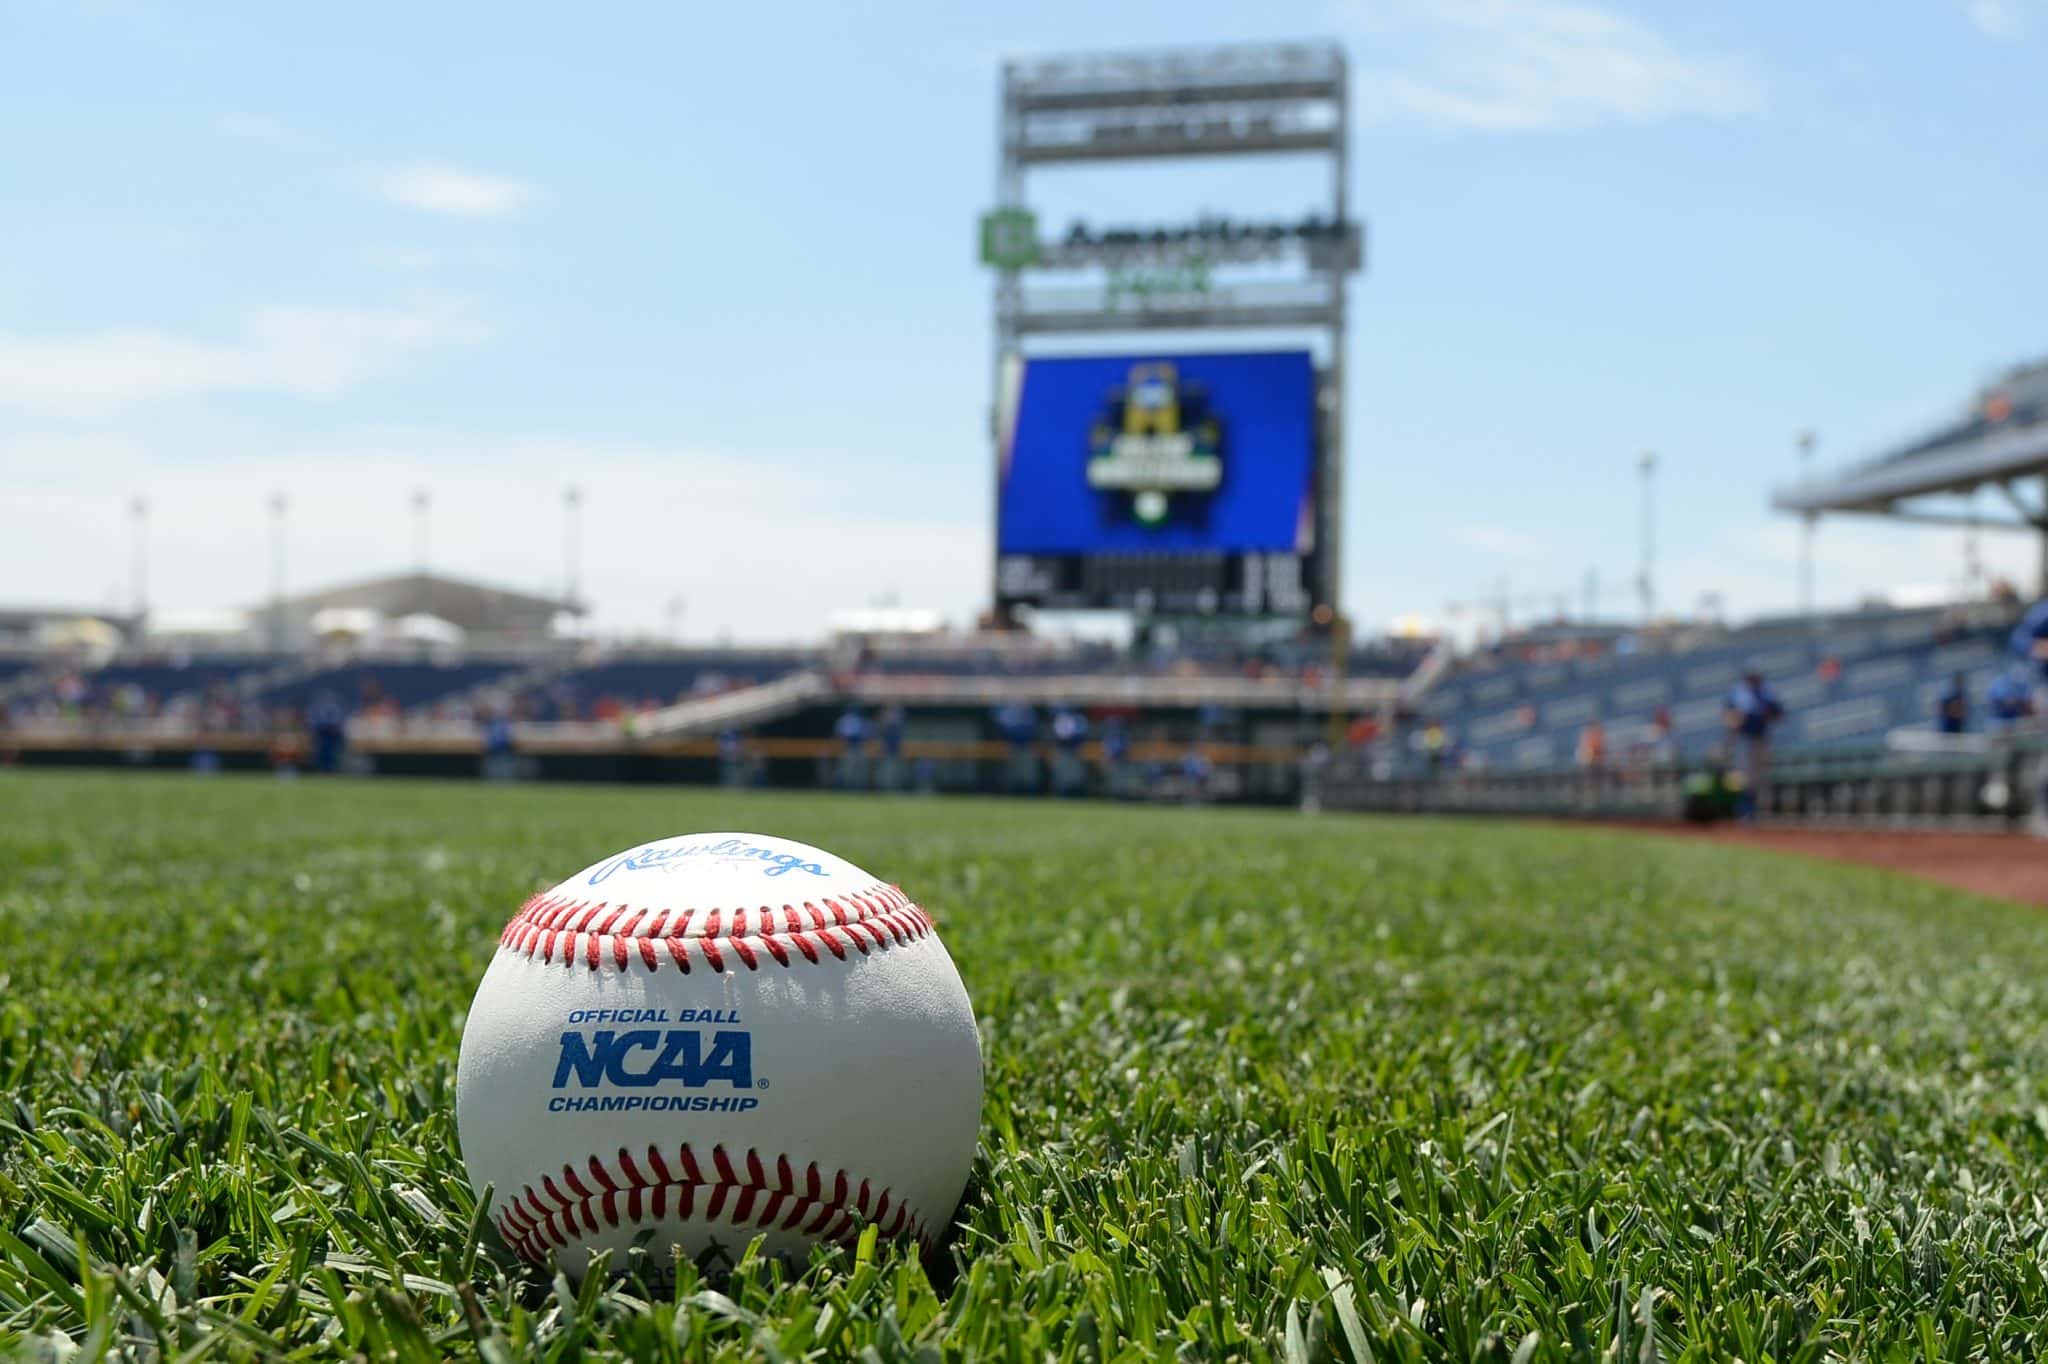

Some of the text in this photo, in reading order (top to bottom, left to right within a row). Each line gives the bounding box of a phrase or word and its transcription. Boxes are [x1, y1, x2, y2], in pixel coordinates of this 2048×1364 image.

[588, 839, 830, 885] Rawlings
[569, 1009, 741, 1023] OFFICIAL BALL
[552, 1030, 752, 1088] NCAA
[549, 1096, 759, 1112] CHAMPIONSHIP
